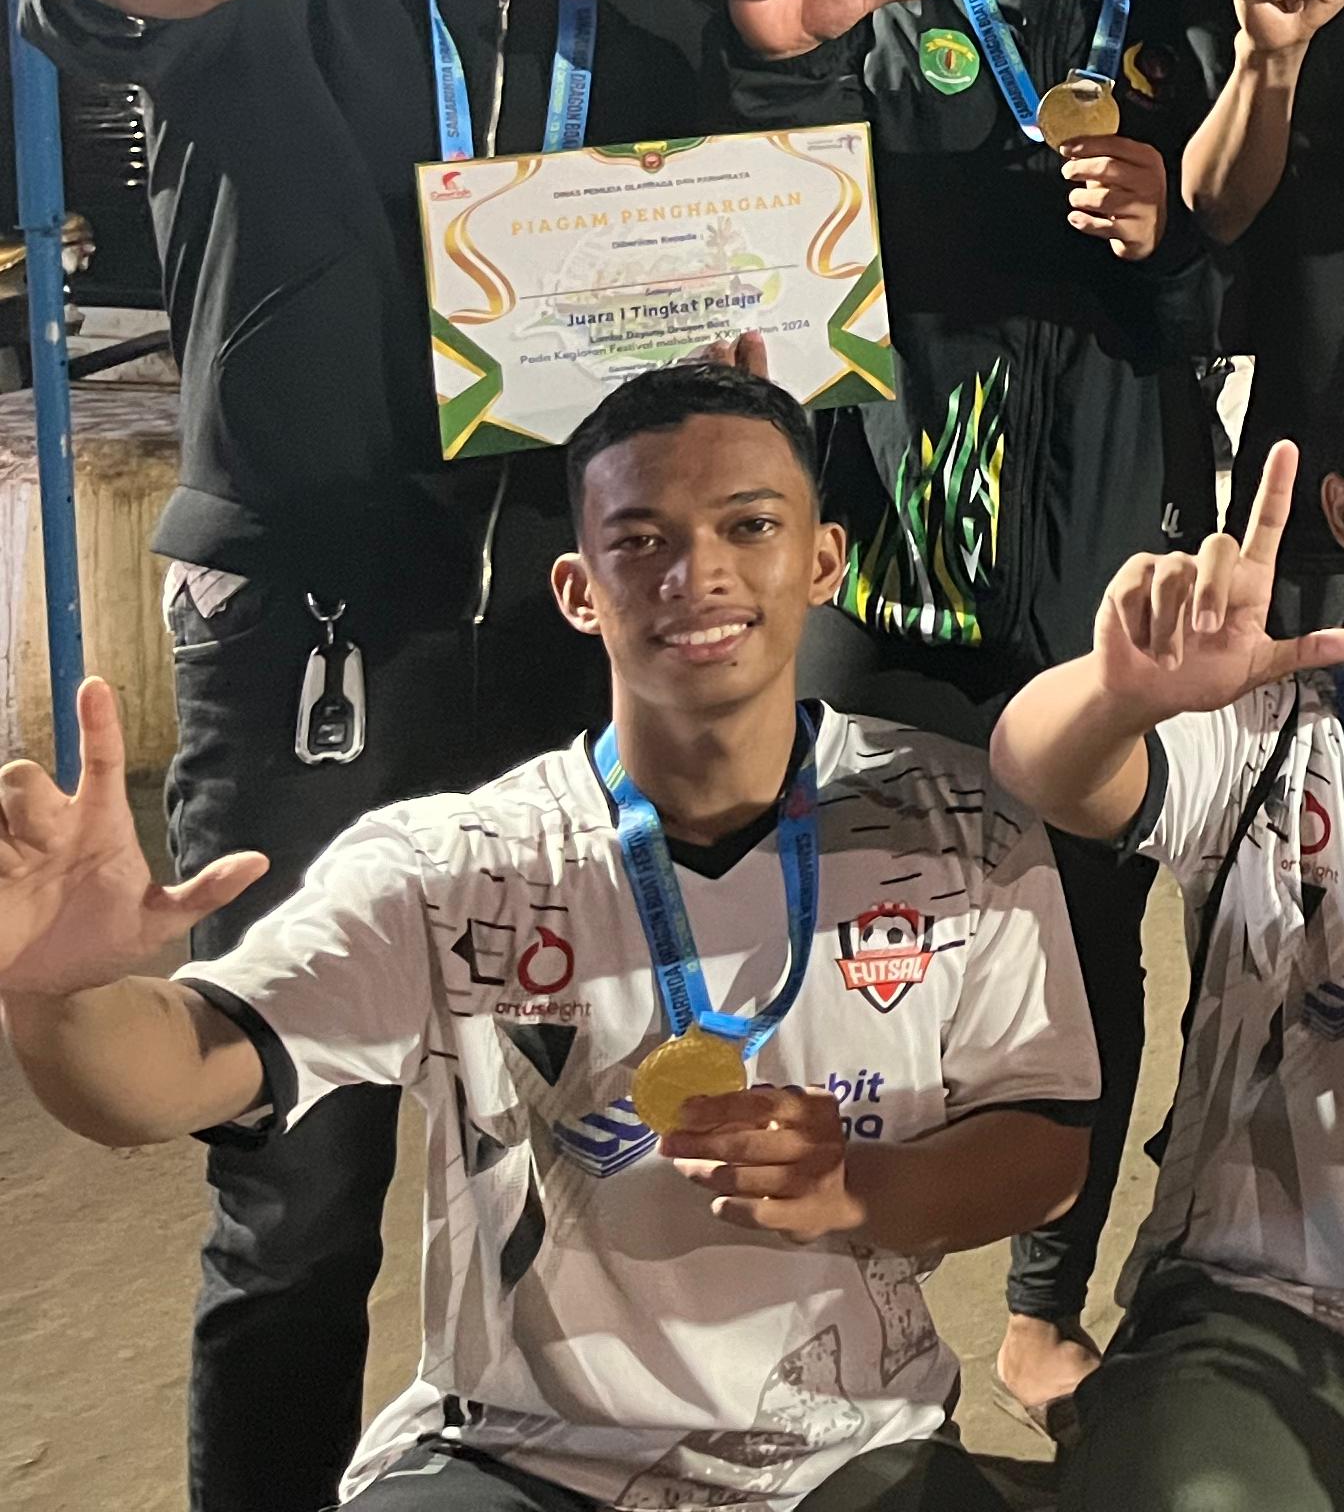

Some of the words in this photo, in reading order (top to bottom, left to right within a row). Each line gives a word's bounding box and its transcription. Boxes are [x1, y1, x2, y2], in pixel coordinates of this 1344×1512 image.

[971, 1, 991, 28] BOAT
[565, 72, 585, 120] DRAGON
[511, 213, 608, 235] PIAGAM
[621, 192, 802, 224] PENGHARGAAN
[567, 311, 614, 327] Juara
[630, 299, 699, 319] Tingkat
[704, 292, 762, 309] Pelajar
[782, 319, 810, 332] 2024
[846, 960, 926, 986] FUTSAL
[495, 1000, 592, 1022] ortuseight
[662, 964, 695, 1029] MARINDA
